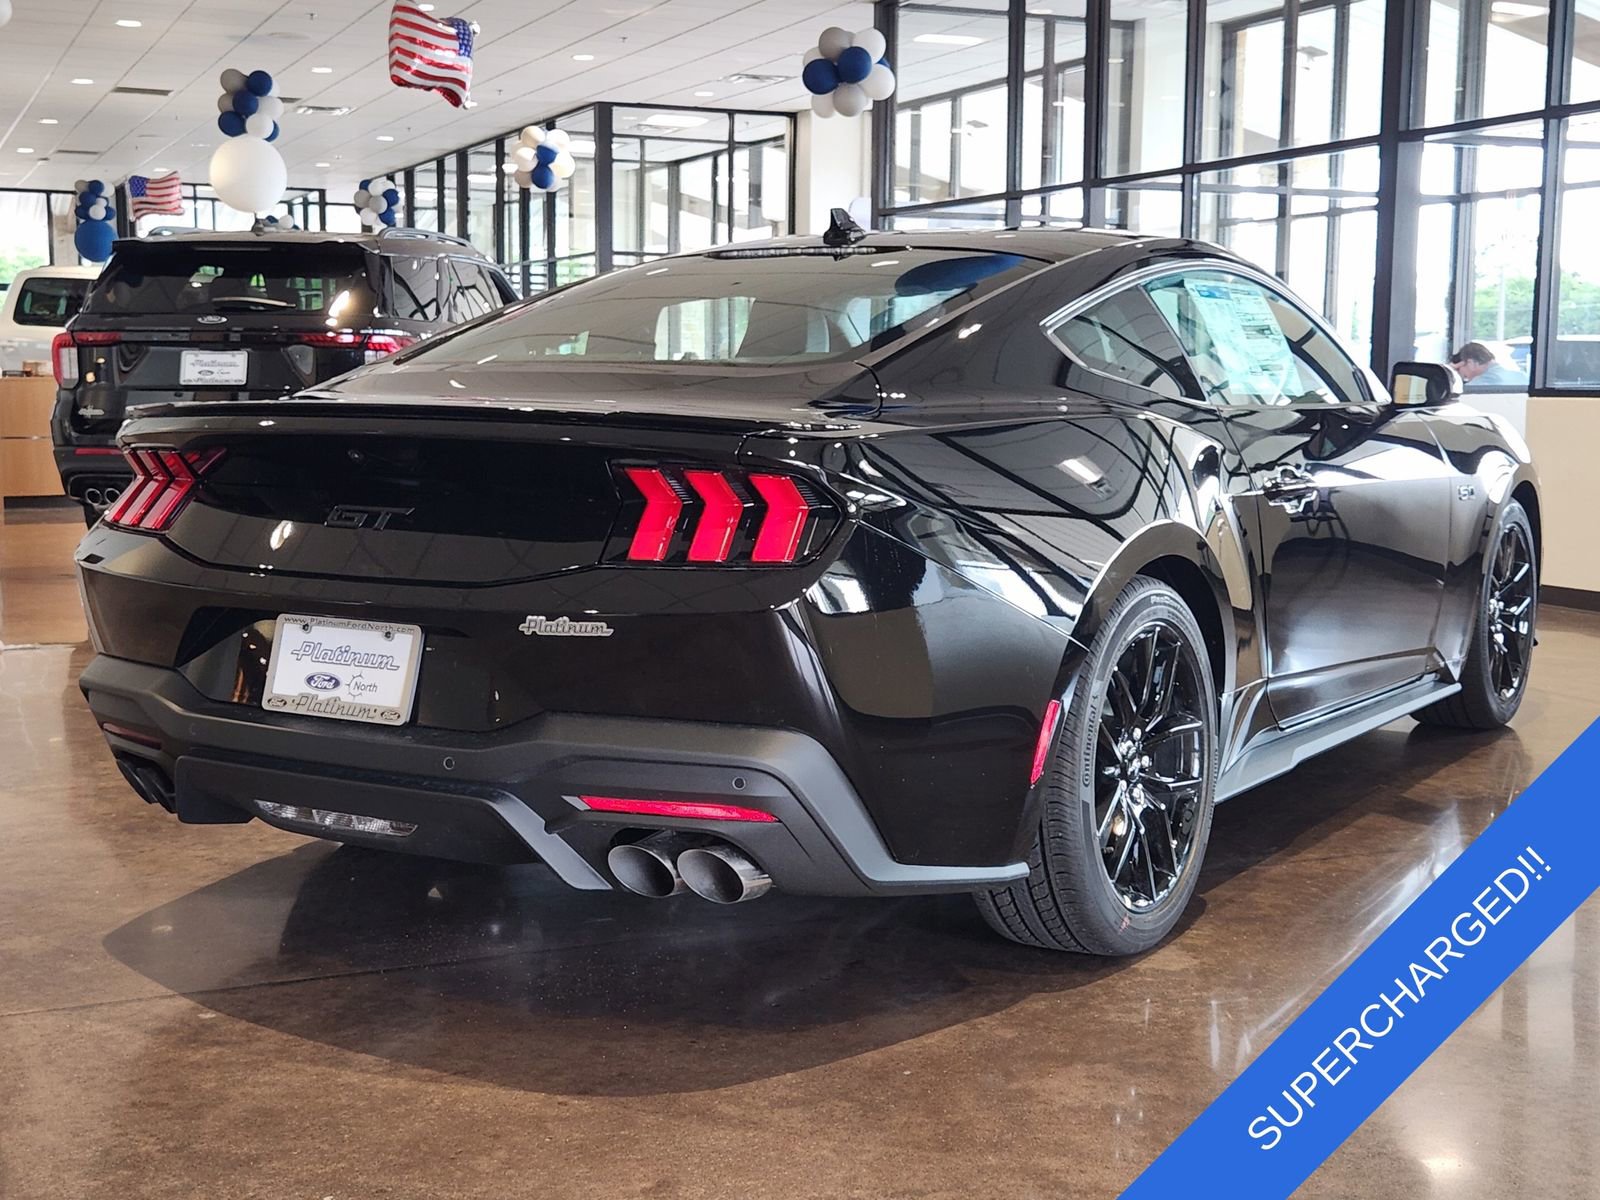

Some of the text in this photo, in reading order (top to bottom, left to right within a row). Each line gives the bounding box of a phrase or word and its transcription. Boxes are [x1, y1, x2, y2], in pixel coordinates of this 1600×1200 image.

[324, 505, 415, 530] GT
[284, 616, 415, 633] www.PlatinumFordNorth.com
[519, 616, 614, 636] Platinum
[291, 641, 400, 671] Platinum
[310, 674, 335, 690] Ford
[354, 681, 378, 693] North
[294, 695, 377, 719] Platinum
[1082, 704, 1098, 788] Continental
